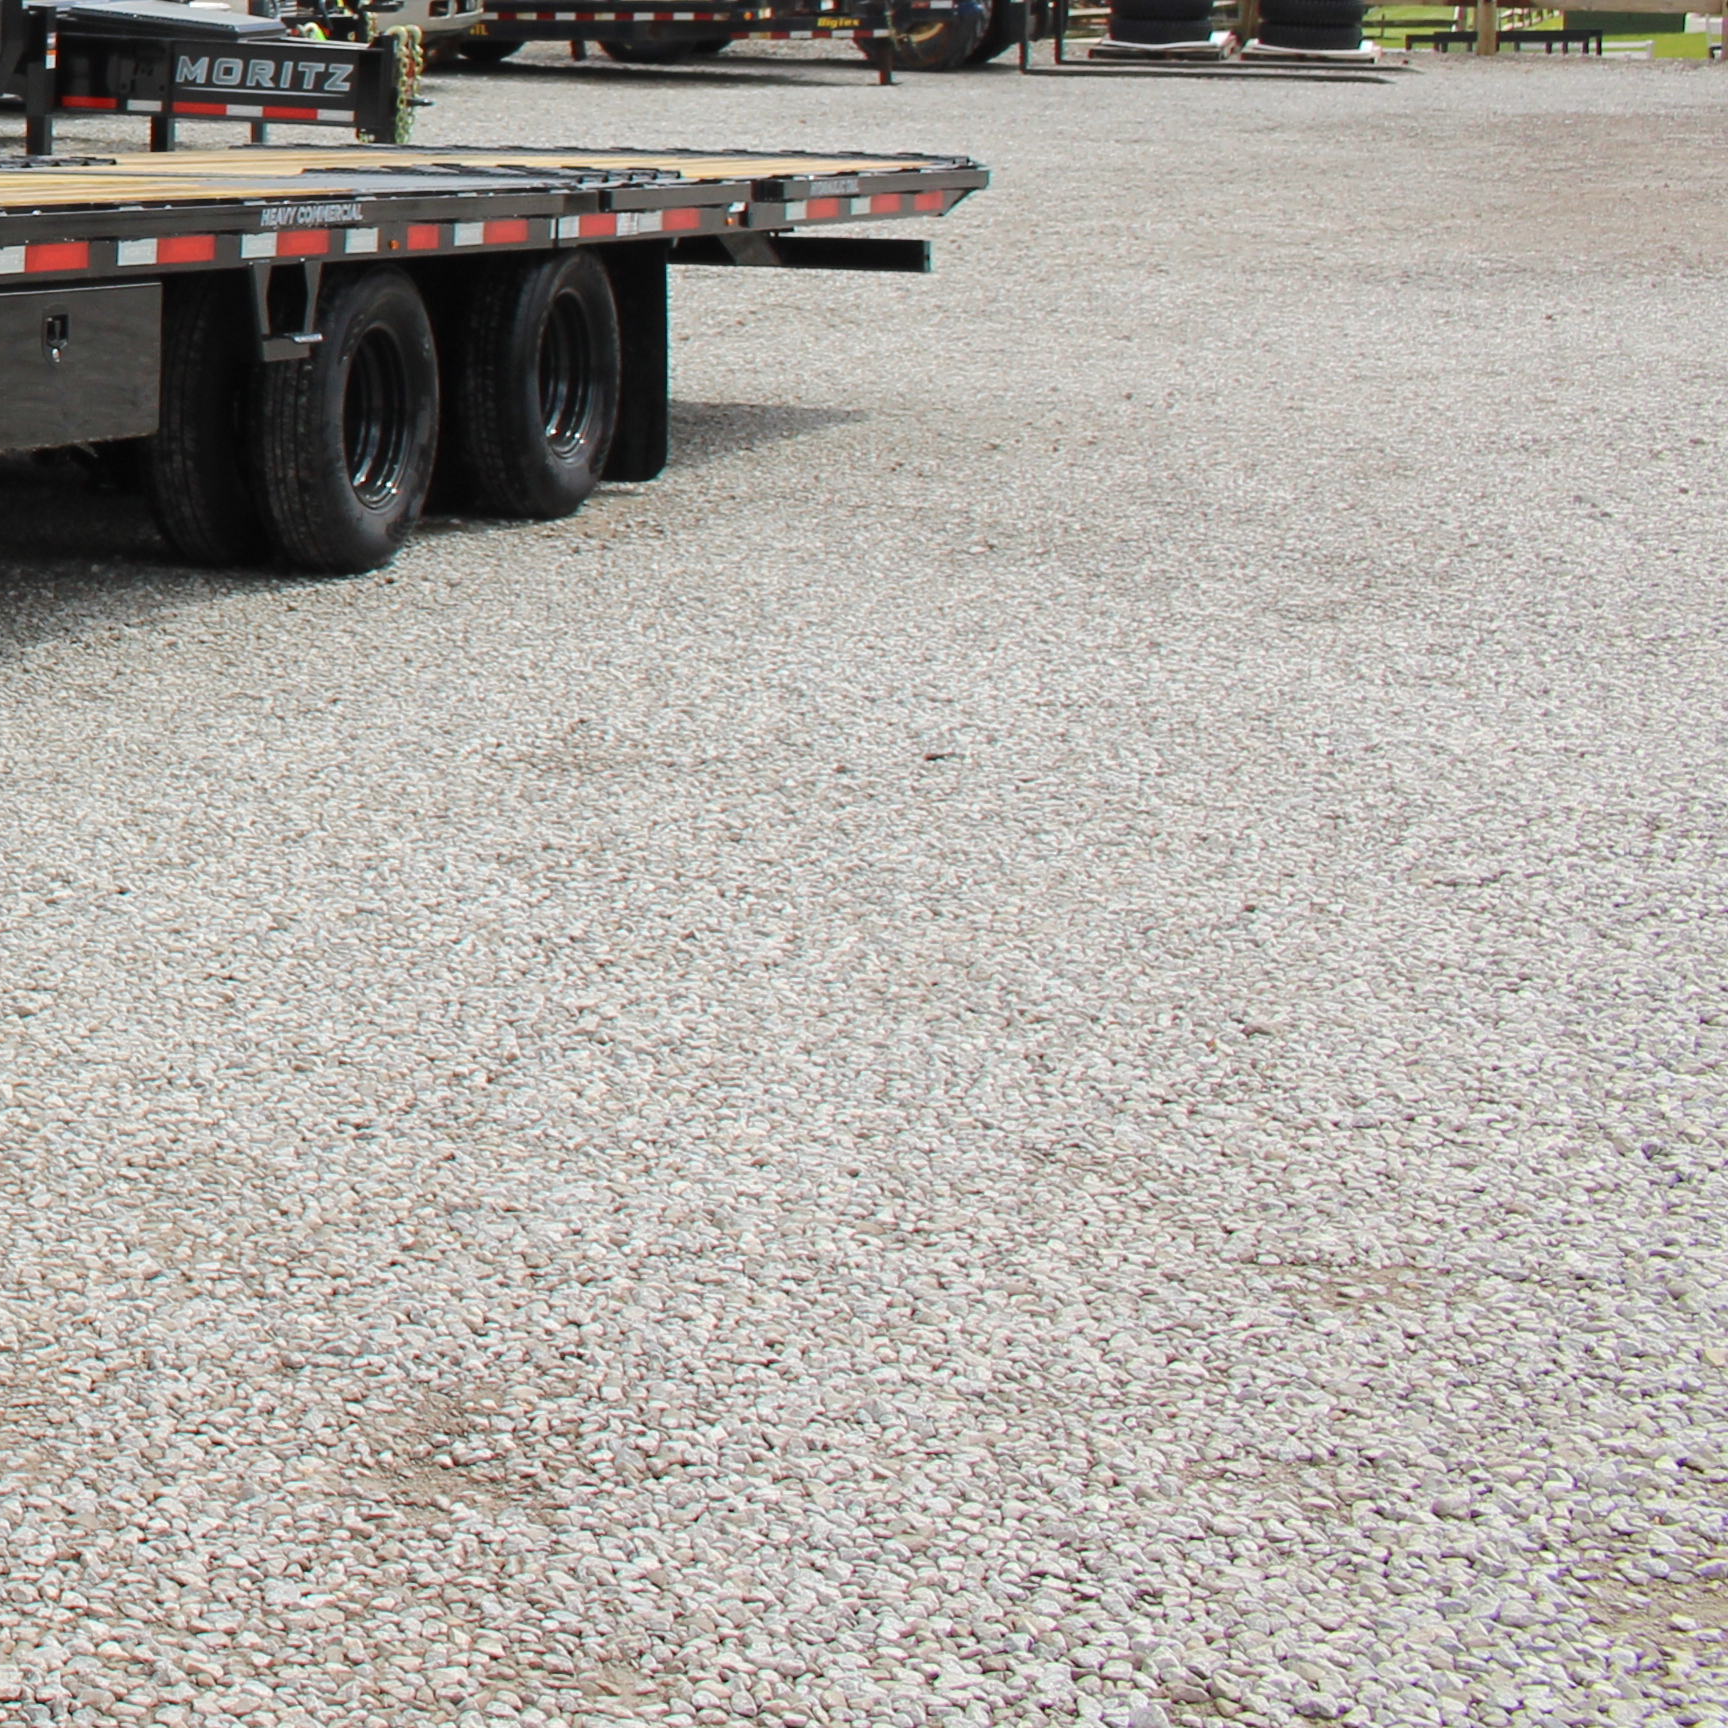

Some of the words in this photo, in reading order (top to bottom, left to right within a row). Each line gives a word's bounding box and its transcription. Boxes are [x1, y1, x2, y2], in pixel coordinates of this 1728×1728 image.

[174, 55, 355, 92] MORITZ
[261, 206, 296, 227] HEAVY
[297, 203, 363, 224] COMMERCIAL
